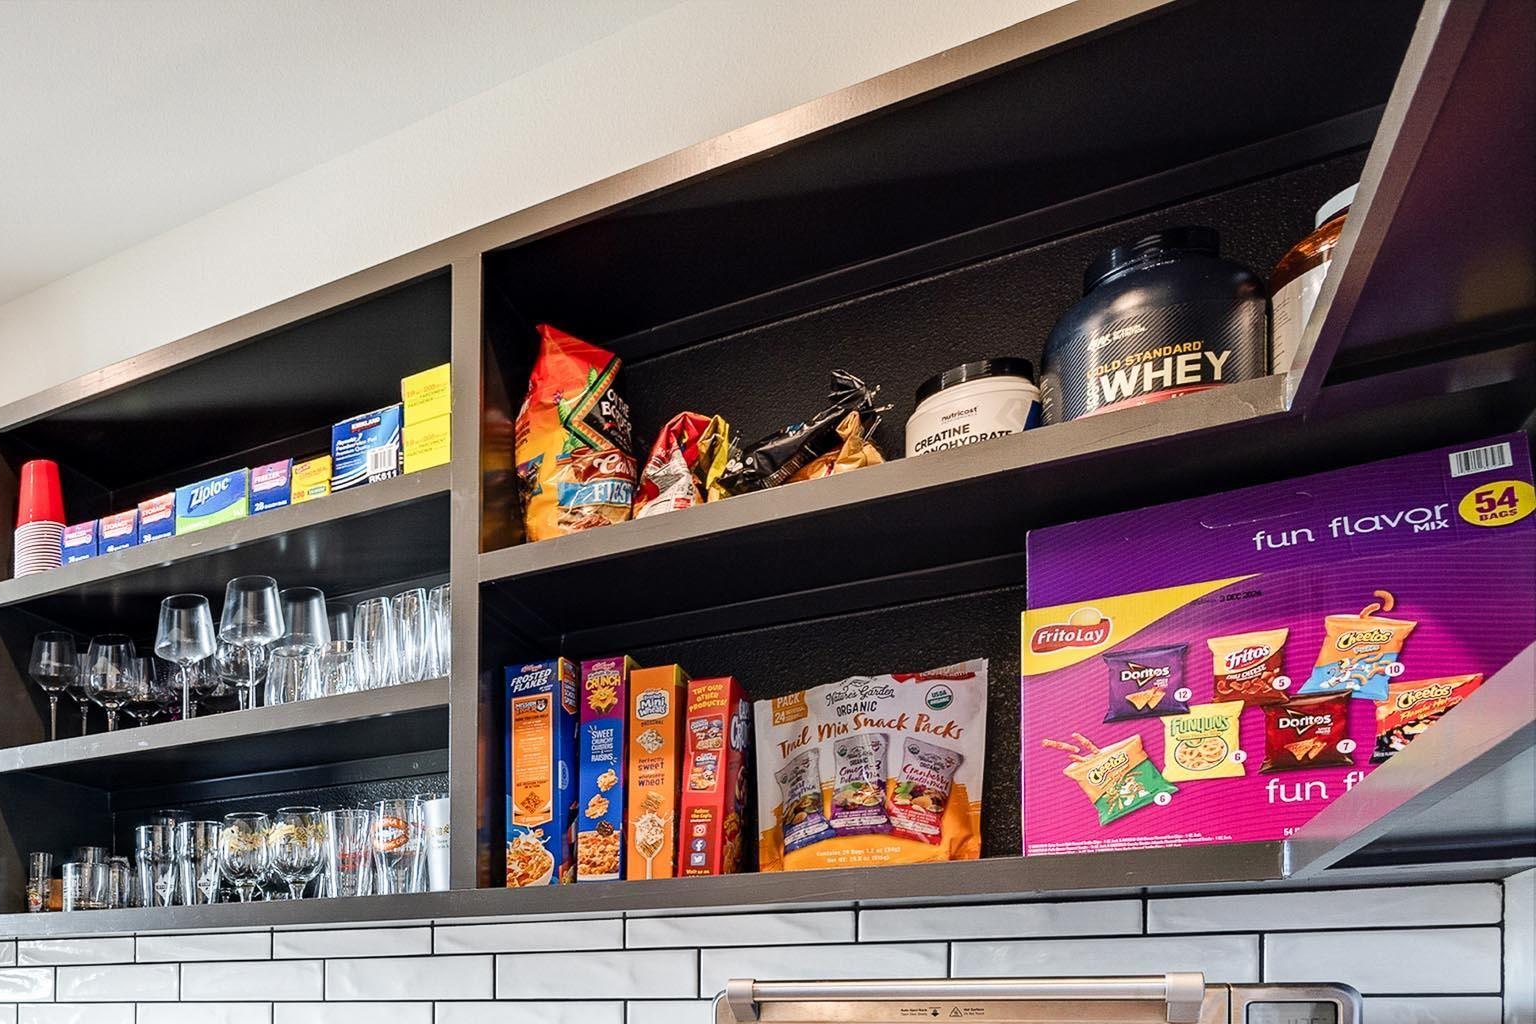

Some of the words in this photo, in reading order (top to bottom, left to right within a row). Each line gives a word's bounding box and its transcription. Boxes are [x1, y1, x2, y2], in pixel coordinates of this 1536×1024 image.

[1087, 359, 1121, 379] GOLD
[1125, 340, 1202, 366] STANDARD
[1100, 350, 1231, 403] WHEY
[941, 406, 977, 421] nutricost
[914, 423, 970, 453] CREATINE
[368, 470, 397, 484] RK611
[190, 477, 230, 509] Ziploc
[1475, 486, 1519, 513] 54
[1479, 509, 1518, 521] BAGS
[1252, 527, 1315, 551] fun
[1328, 503, 1449, 538] flavor
[1413, 519, 1450, 533] MIX
[1337, 629, 1393, 650] Cheetos
[1226, 644, 1271, 670] Fritos
[1121, 666, 1170, 682] Doritos
[1388, 664, 1400, 673] 10
[511, 668, 552, 687] FROSTED
[585, 675, 621, 690] CRUNCH
[1278, 678, 1285, 687] 5
[513, 678, 548, 693] FLAKES
[692, 687, 706, 695] TRY
[858, 685, 895, 700] Garden
[696, 692, 719, 702] OTHER
[777, 692, 801, 708] PACK
[1178, 690, 1188, 699] 12
[1397, 685, 1452, 709] Cheetos
[640, 697, 665, 710] Mini
[689, 699, 727, 712] PRODUCTS!
[837, 701, 878, 717] ORGANIC
[775, 711, 785, 724] 24
[1279, 714, 1332, 729] Doritos
[592, 729, 613, 739] SWEET
[777, 725, 812, 759] Trail
[817, 721, 849, 742] Mix
[853, 712, 911, 732] Snack
[914, 713, 964, 740] Packs
[1343, 742, 1349, 751] 7
[591, 753, 613, 762] RAISINS
[1235, 753, 1241, 761] 6
[1088, 752, 1129, 785] Cheetos
[1159, 794, 1166, 803] 6
[1265, 778, 1329, 804] fun
[1284, 828, 1293, 836] 54
